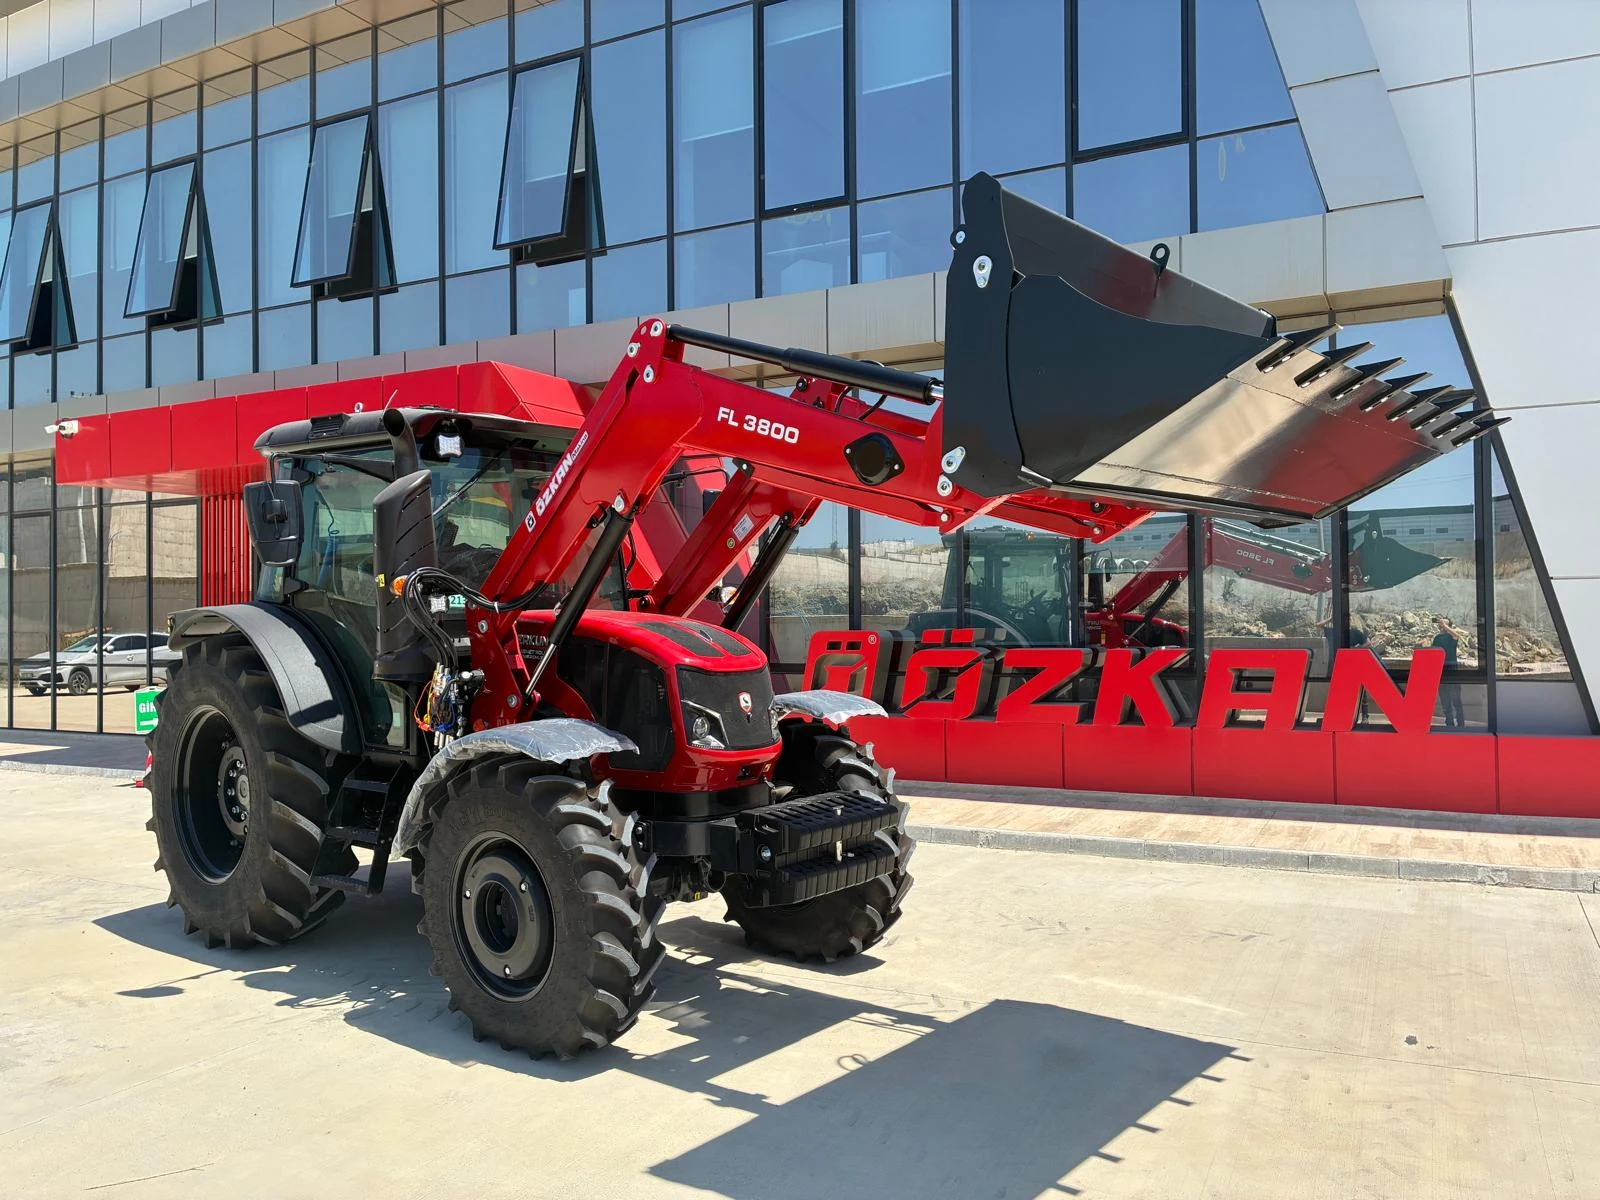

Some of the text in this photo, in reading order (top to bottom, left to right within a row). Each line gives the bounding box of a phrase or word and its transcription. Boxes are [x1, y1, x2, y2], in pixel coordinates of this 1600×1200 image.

[717, 406, 800, 444] FL 3800
[535, 452, 574, 517] ÖZKAN
[518, 633, 550, 647] ERKUN
[901, 628, 1446, 733] ÖZKAN
